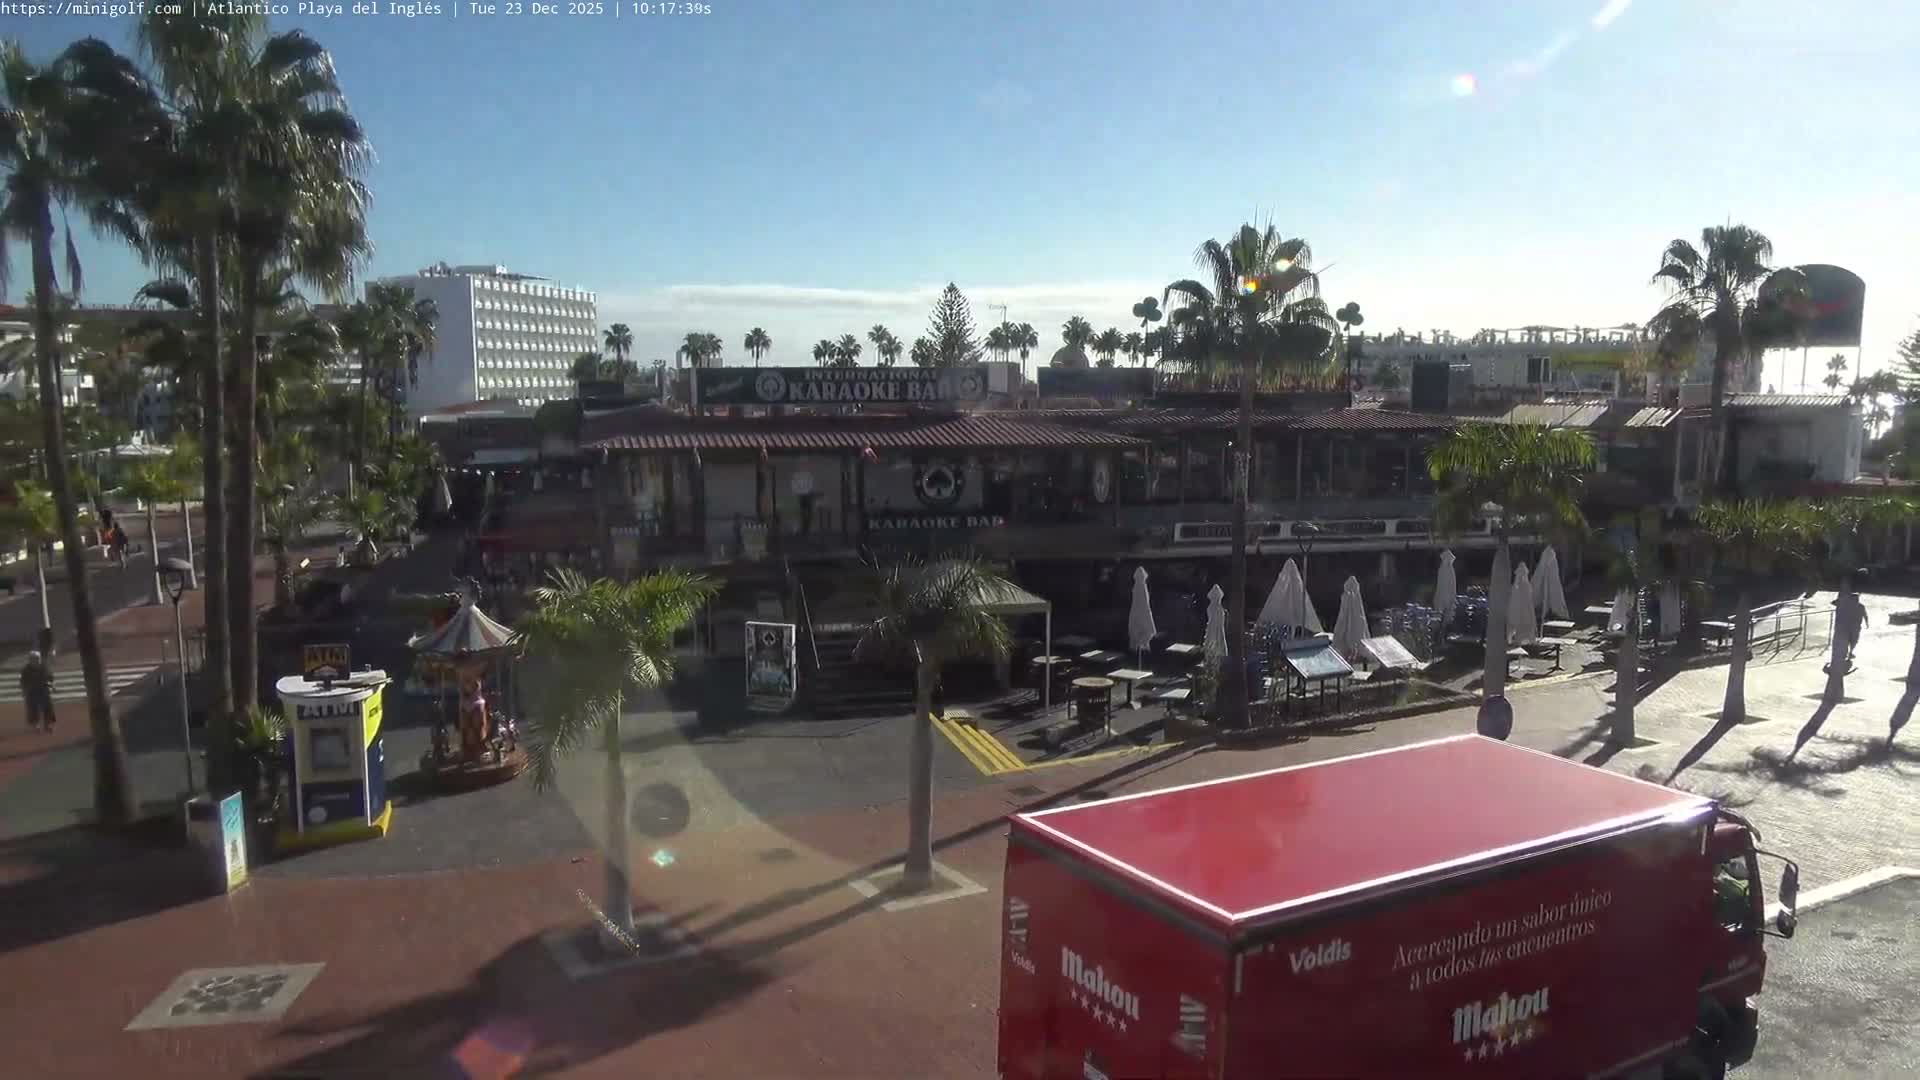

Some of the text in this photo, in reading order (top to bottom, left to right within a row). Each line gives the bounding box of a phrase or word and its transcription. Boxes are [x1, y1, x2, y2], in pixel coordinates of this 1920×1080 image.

[790, 382, 900, 400] KARAOKE
[868, 518, 960, 529] KARAOKE
[303, 701, 353, 717] ATM
[1392, 888, 1613, 971] Acercando un sabor único
[1425, 950, 1476, 986] todos
[1506, 918, 1597, 961] encuentros
[1288, 937, 1352, 974] Voldis
[1060, 946, 1141, 1022] Mahou
[1451, 986, 1550, 1044] Mahou
